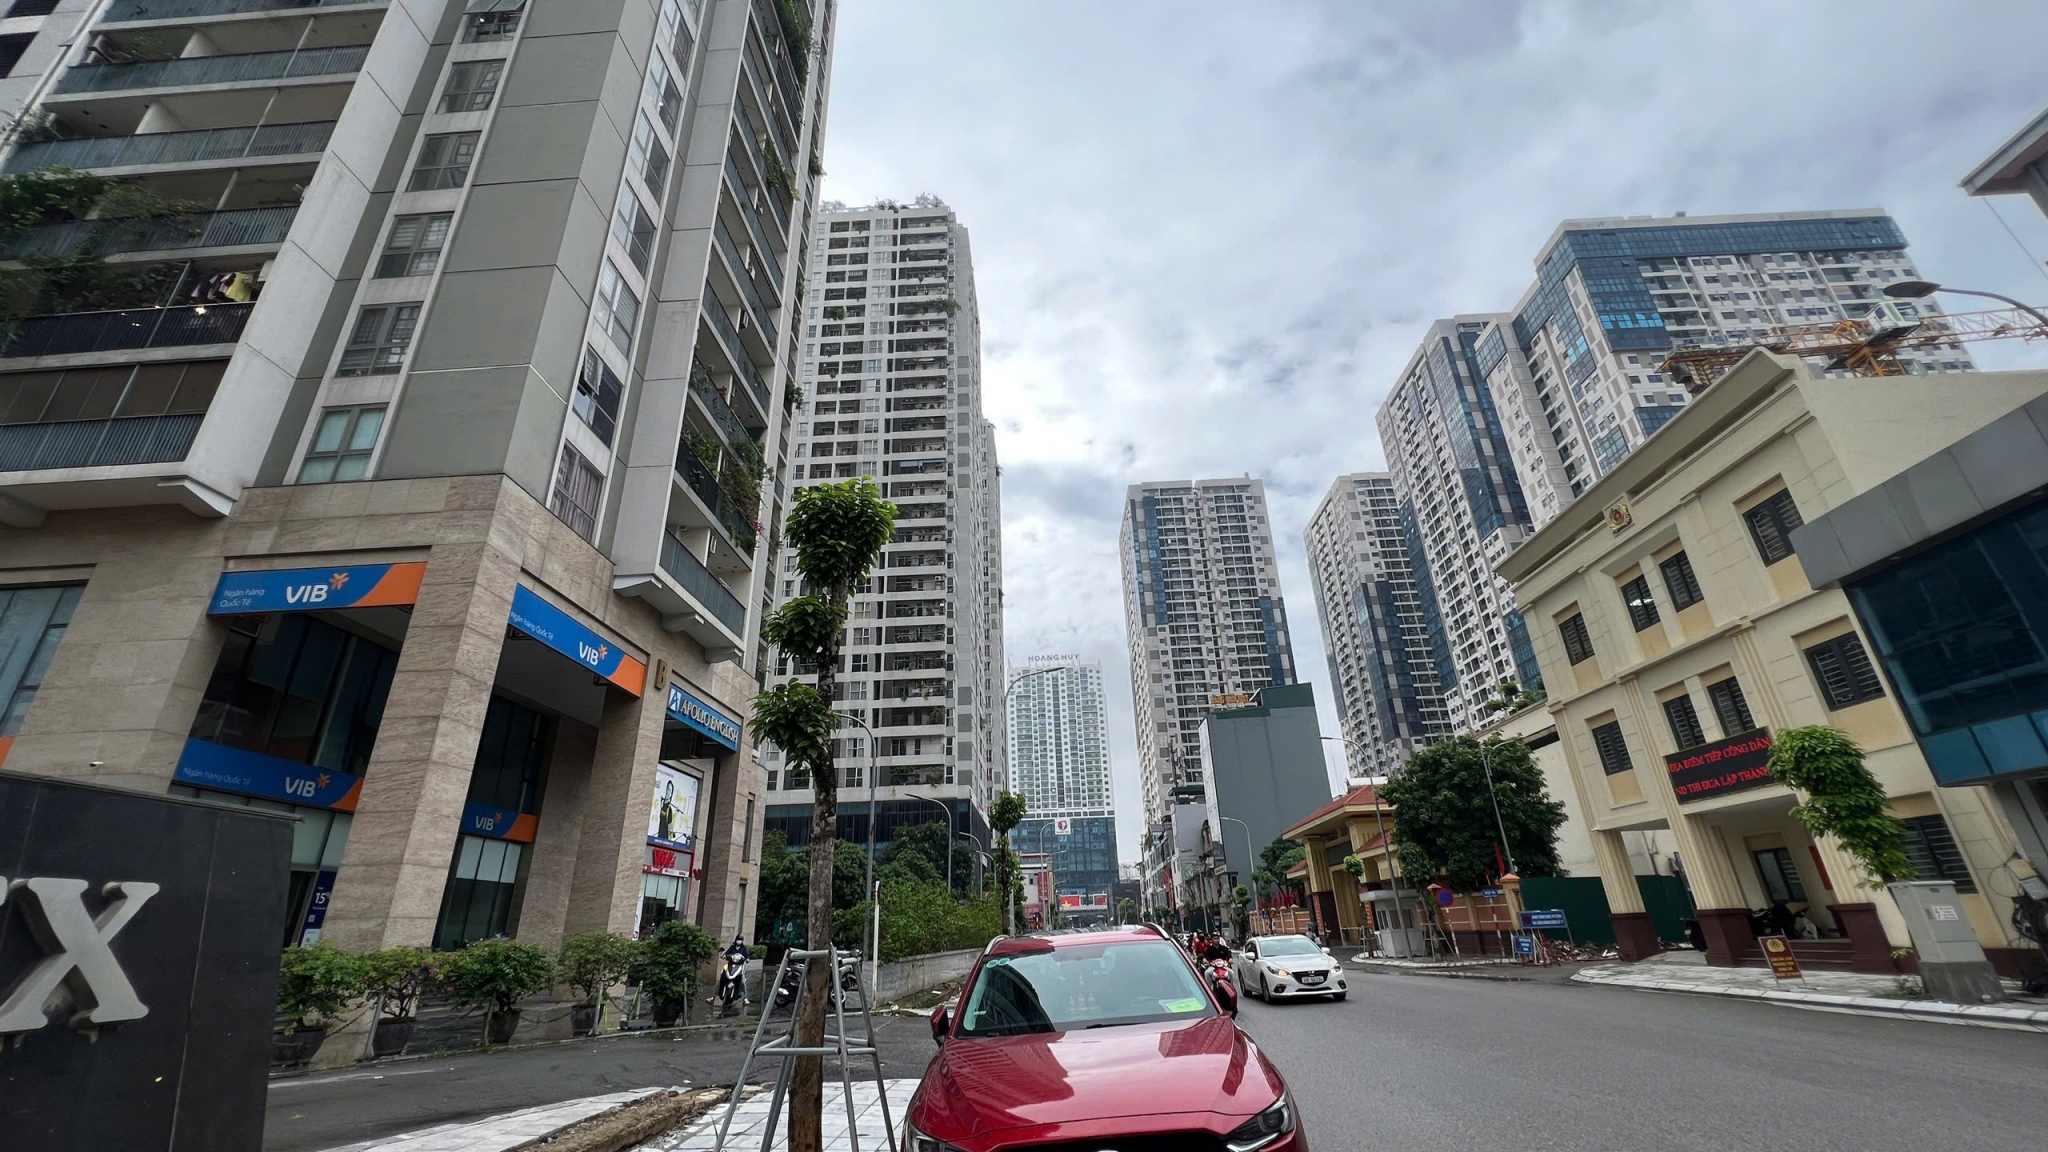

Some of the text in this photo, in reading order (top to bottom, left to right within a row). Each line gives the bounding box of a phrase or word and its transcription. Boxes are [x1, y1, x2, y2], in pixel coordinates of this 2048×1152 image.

[286, 584, 328, 604] VIB
[579, 641, 599, 666] VIB
[1028, 654, 1059, 662] HOANG
[654, 658, 669, 690] B
[680, 699, 739, 743] APOLLO ENGLISH
[1722, 744, 1749, 758] CÔNG
[1748, 737, 1771, 751] DÂN
[285, 776, 317, 798] VIB
[1688, 783, 1702, 793] THI
[475, 815, 494, 831] VIB
[0, 876, 160, 1032] X
